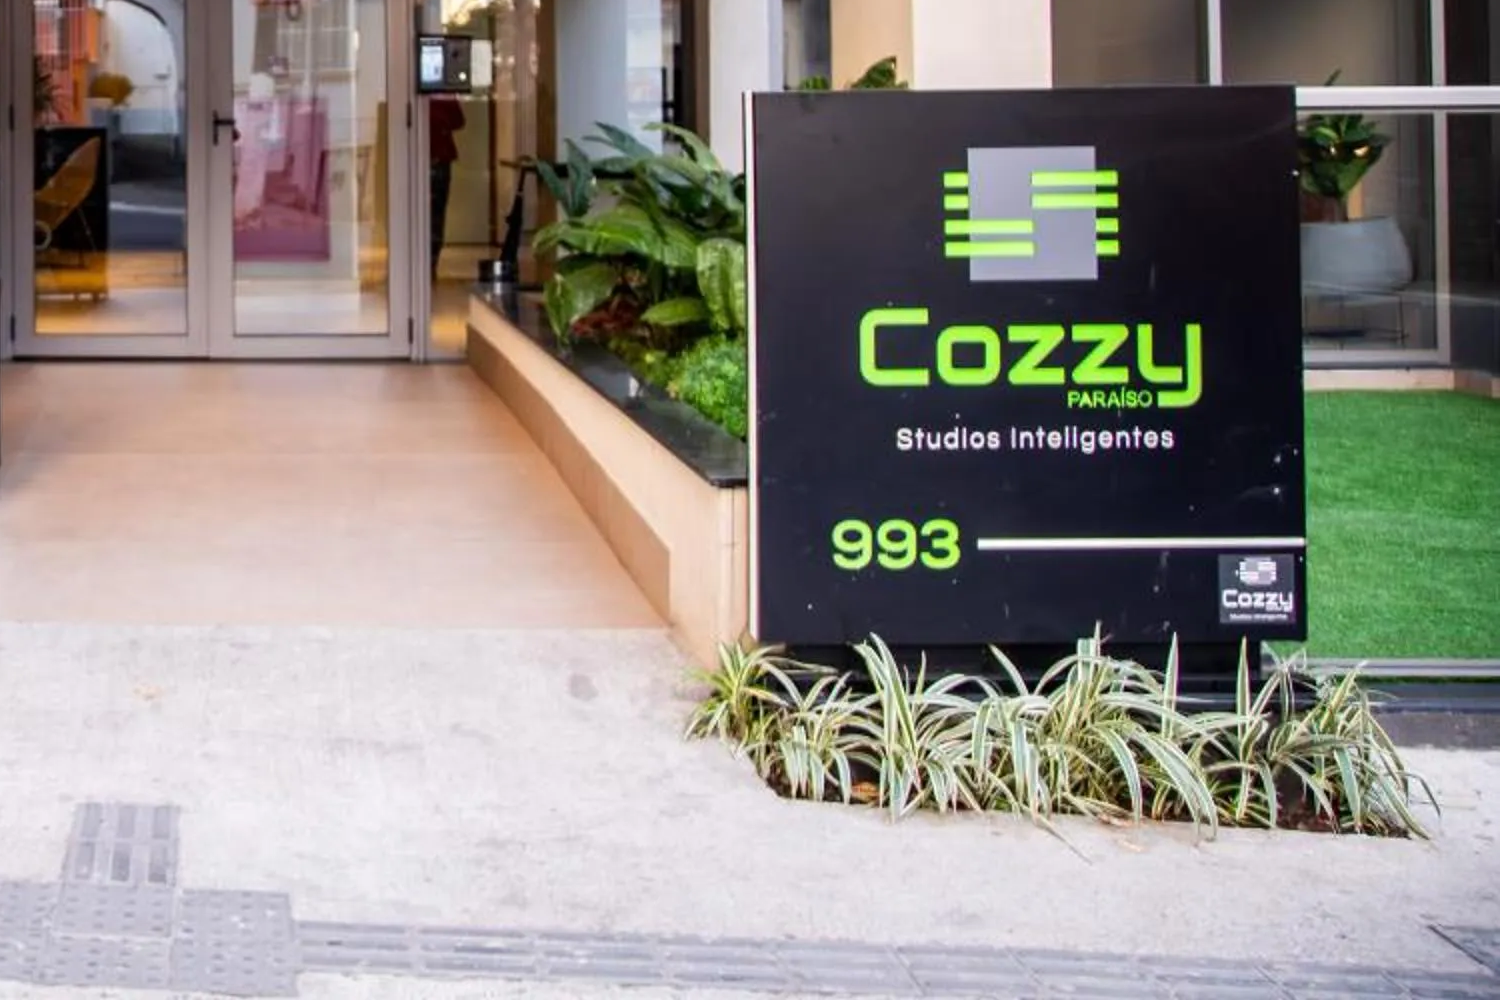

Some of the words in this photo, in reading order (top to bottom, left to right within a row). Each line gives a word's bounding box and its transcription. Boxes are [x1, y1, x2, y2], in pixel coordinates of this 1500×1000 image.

[859, 307, 1202, 409] Cozzy
[1066, 386, 1154, 409] PARAÍSO
[895, 427, 1001, 450] Studios
[1010, 426, 1176, 455] Inteligentes
[831, 518, 962, 571] 993
[1221, 588, 1294, 612] Cozzy
